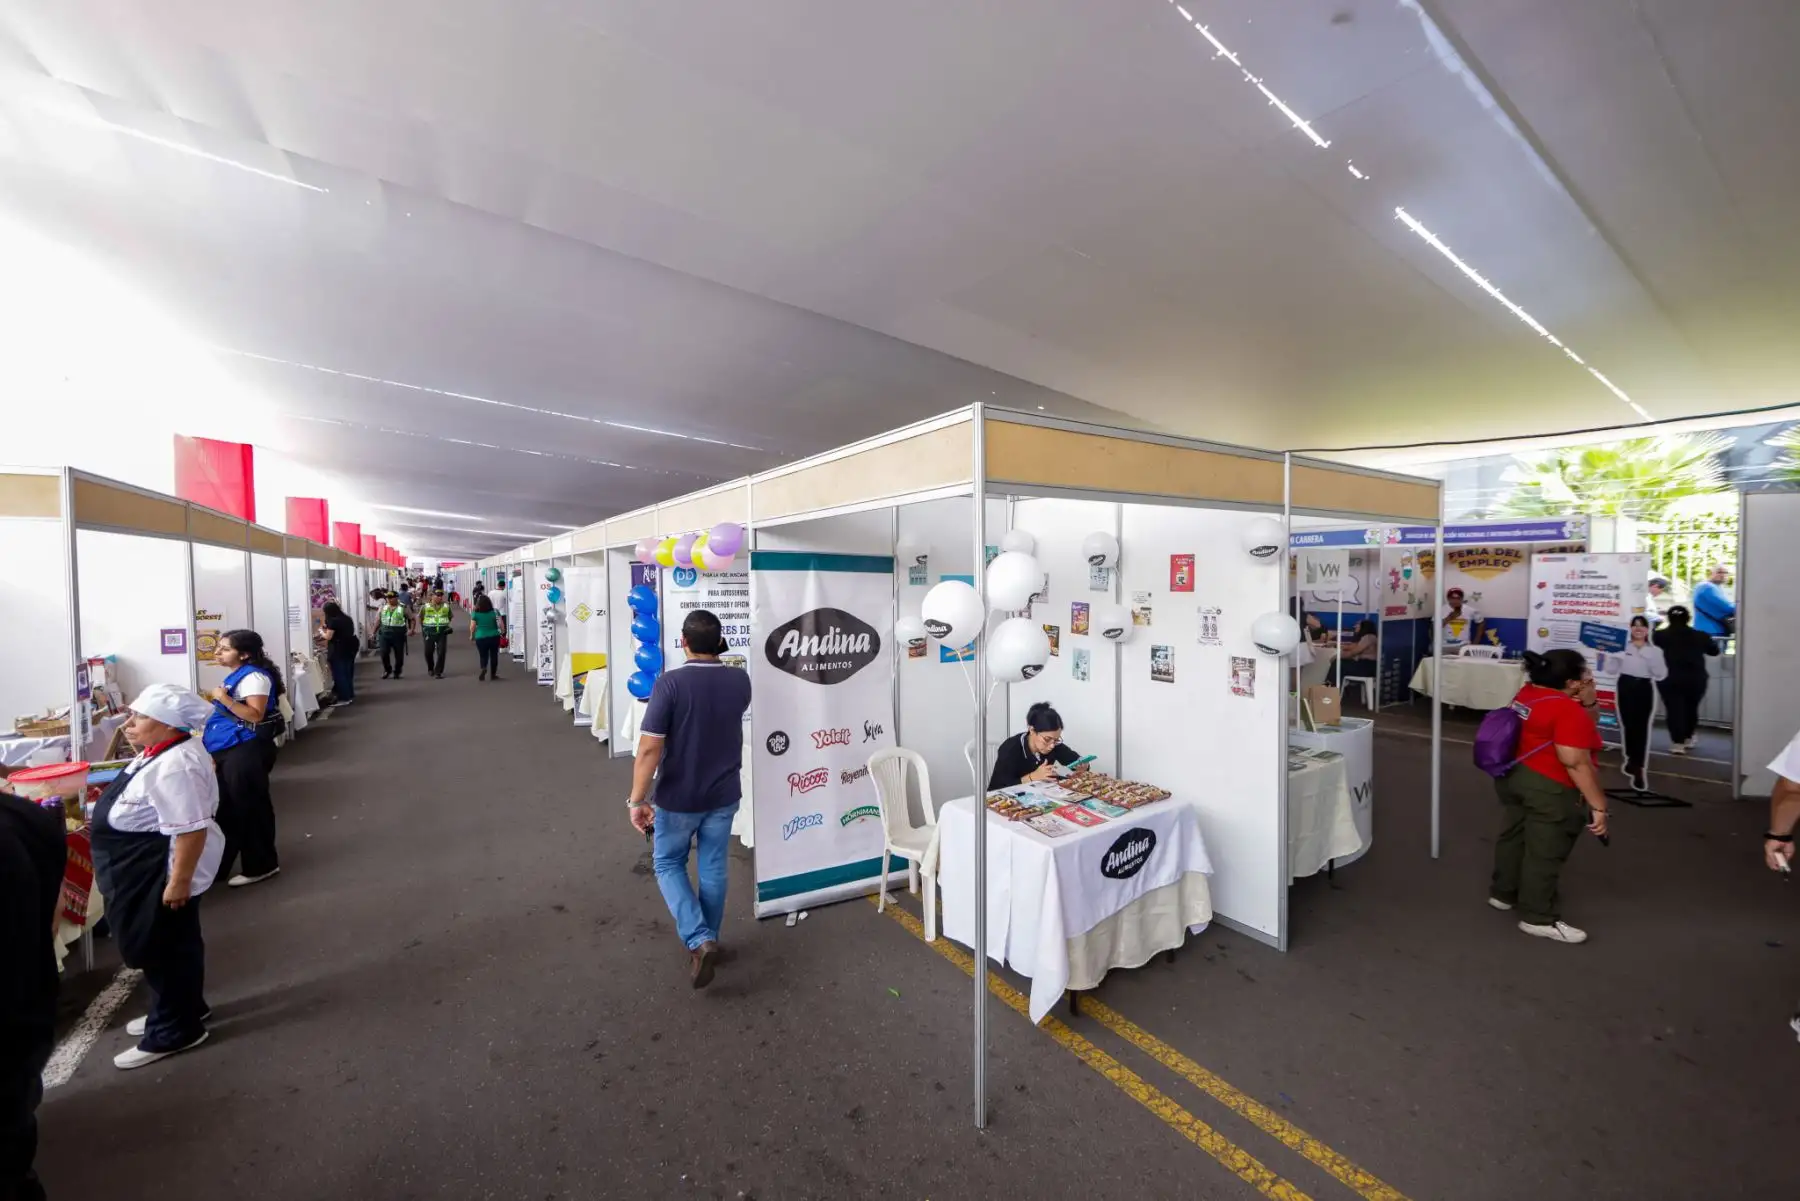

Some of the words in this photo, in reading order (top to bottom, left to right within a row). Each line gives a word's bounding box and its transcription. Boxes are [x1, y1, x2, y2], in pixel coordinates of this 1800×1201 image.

[1448, 548, 1489, 559] FERIA
[1495, 548, 1522, 558] DEL
[1458, 559, 1512, 568] EMPLEO
[1319, 563, 1341, 577] VW
[680, 601, 701, 609] CENTROS
[719, 612, 750, 620] COORPORATIV
[777, 626, 871, 658] Andina
[801, 661, 853, 672] ALIMENTOS
[1105, 837, 1150, 873] Andina
[1117, 856, 1143, 876] ALIMENTOS
